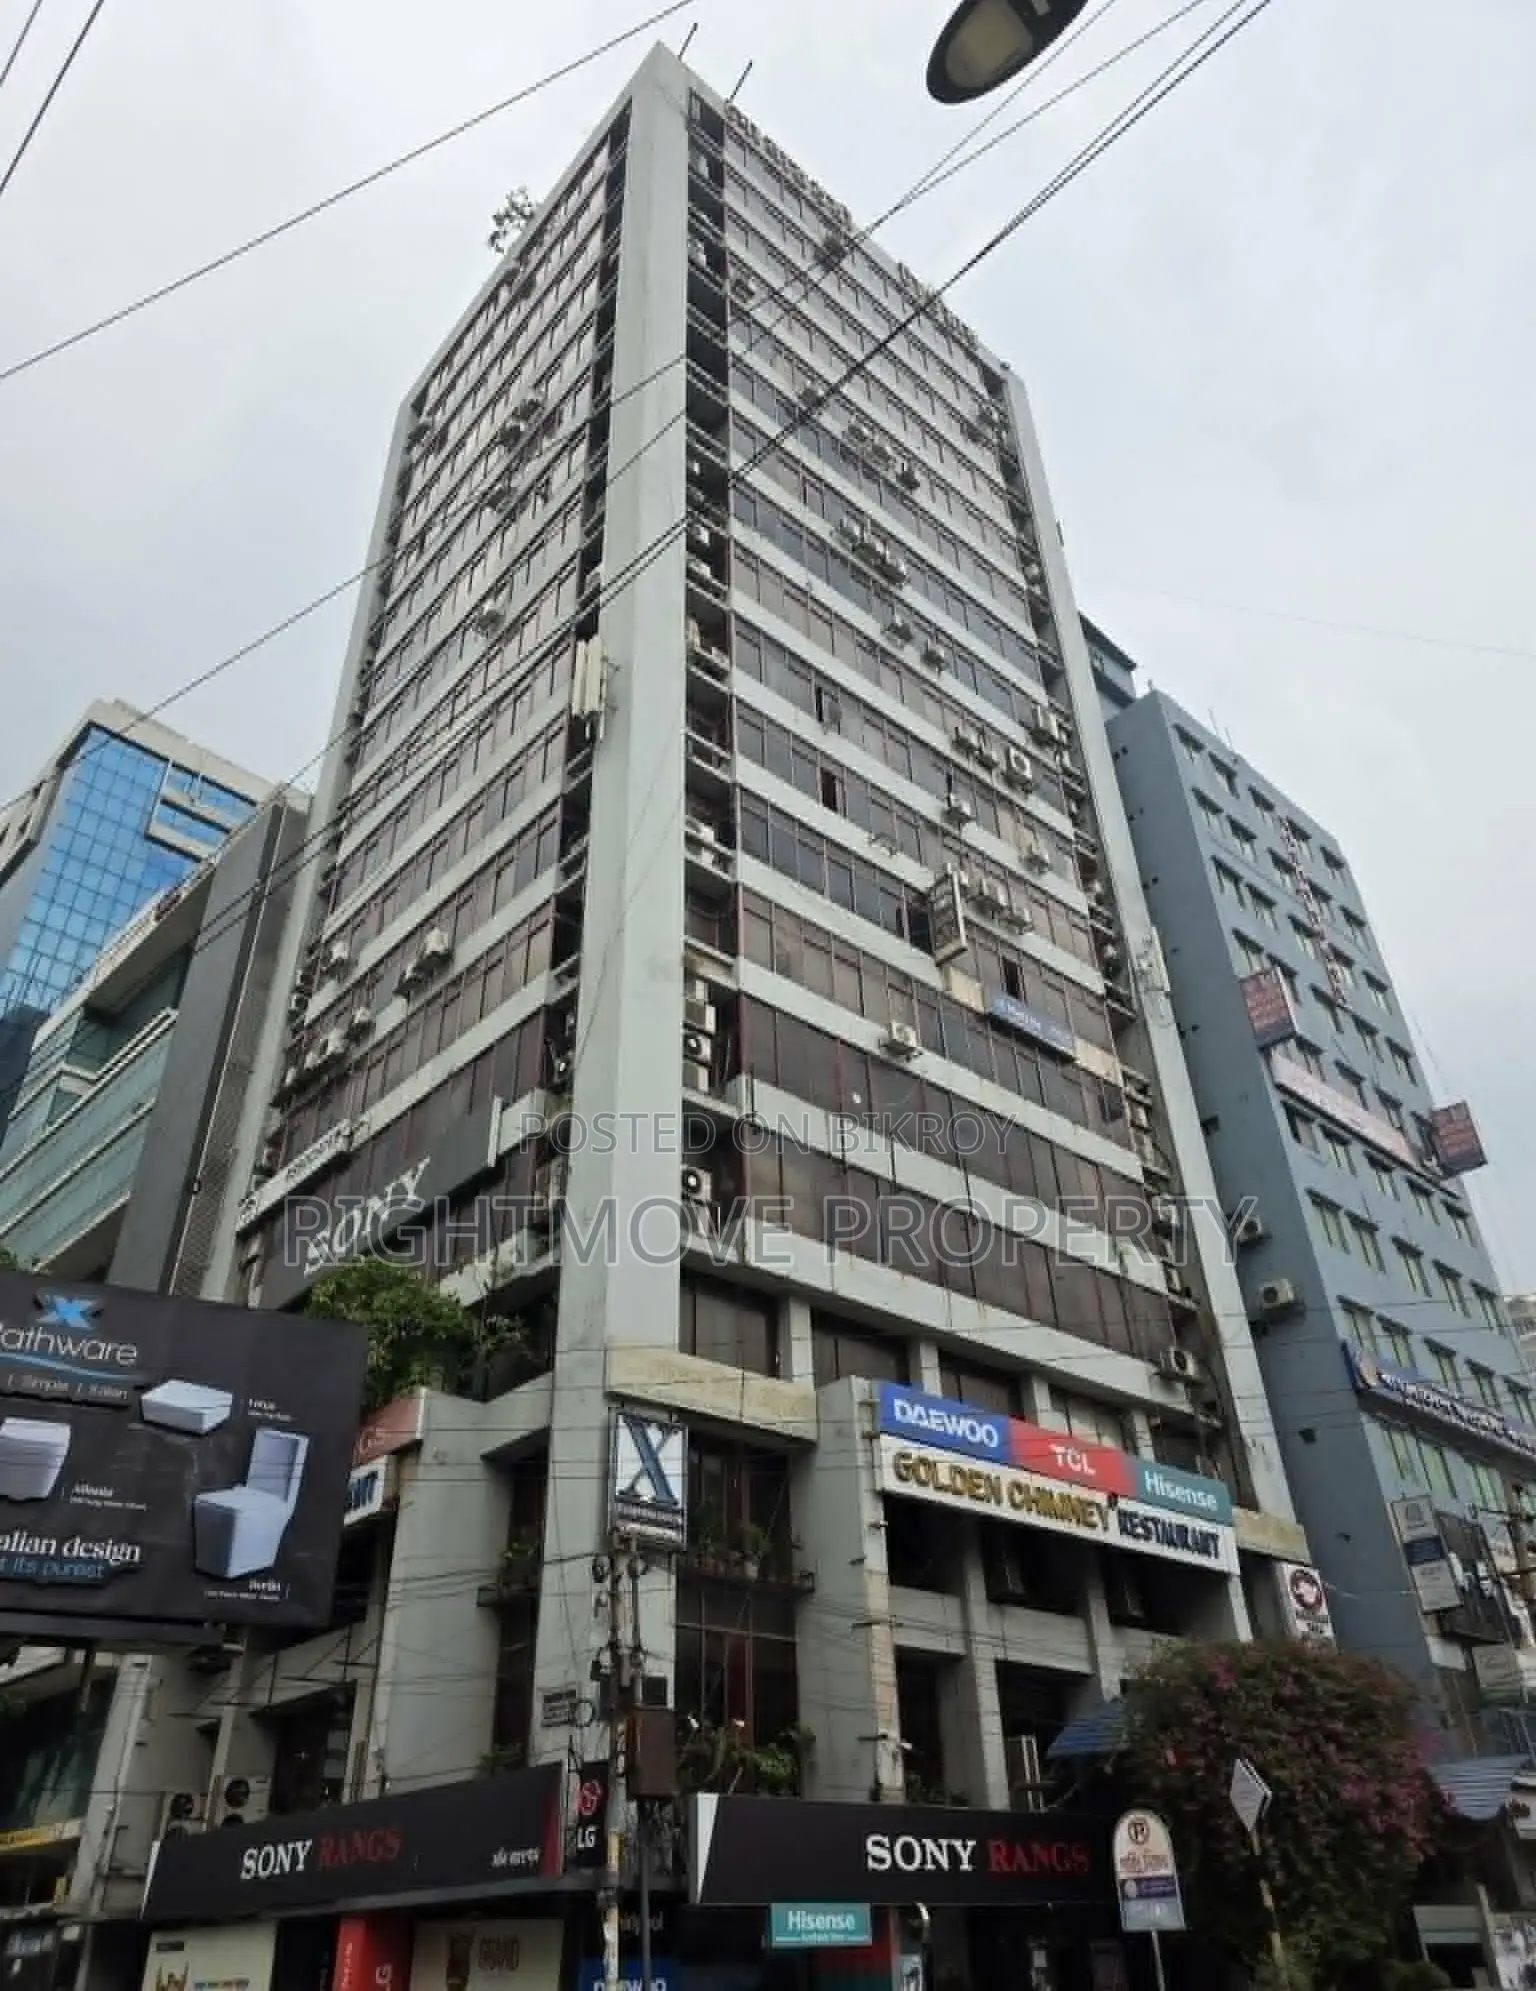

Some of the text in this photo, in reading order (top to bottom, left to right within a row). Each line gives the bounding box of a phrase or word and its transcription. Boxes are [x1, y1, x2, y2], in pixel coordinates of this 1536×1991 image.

[304, 1156, 430, 1277] SONY
[0, 1322, 137, 1367] athware
[893, 1398, 998, 1448] DAEWOO
[1049, 1444, 1097, 1476] TCL
[893, 1451, 1003, 1507] GOLDEN
[1118, 1508, 1219, 1559] RESTAURANT
[1144, 1470, 1218, 1511] Hisense
[62, 1535, 141, 1567] design
[240, 1828, 401, 1881] SONY RANGS
[577, 1825, 597, 1848] LG
[865, 1833, 977, 1873] SONY
[987, 1838, 1089, 1873] RANGS
[788, 1910, 856, 1931] Hisense
